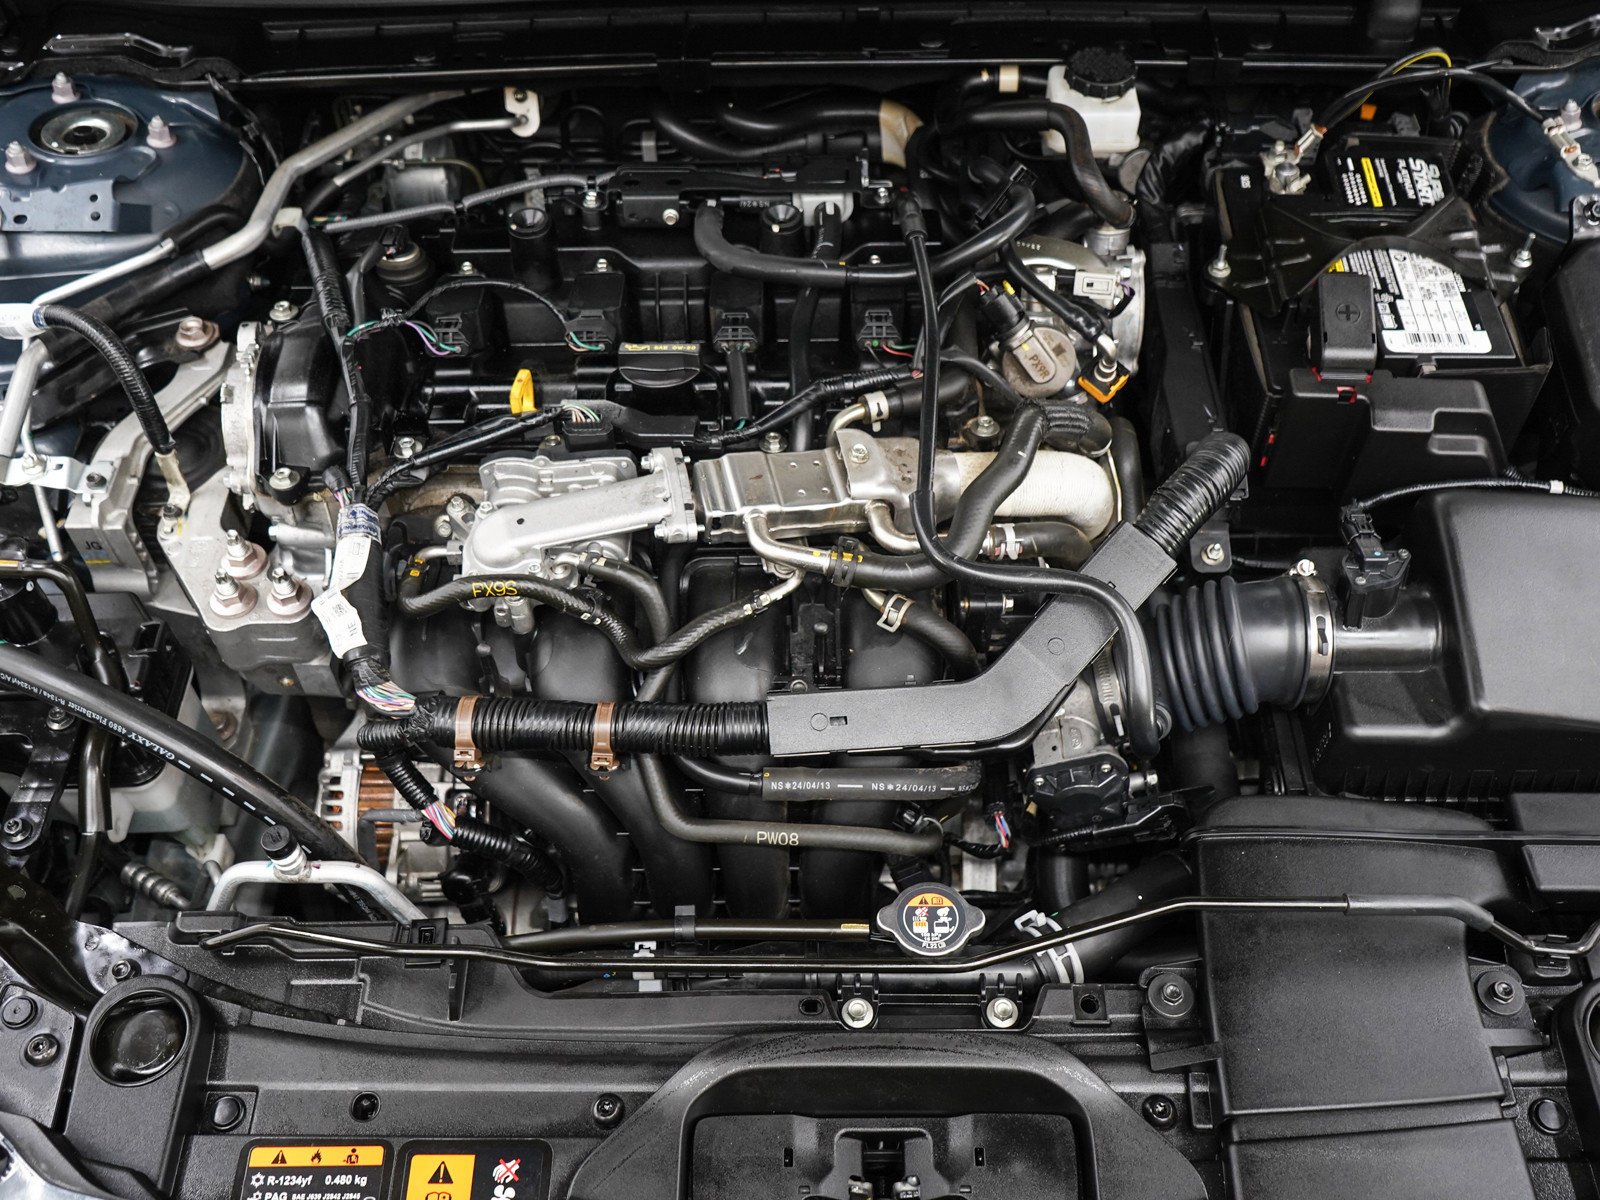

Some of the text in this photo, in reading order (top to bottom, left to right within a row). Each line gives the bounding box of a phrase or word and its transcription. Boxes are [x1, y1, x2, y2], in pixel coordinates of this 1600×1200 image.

[1409, 157, 1436, 207] START
[67, 701, 108, 726] FlexBarrier
[108, 721, 128, 735] 4880
[128, 732, 176, 760] GALAXY
[756, 831, 800, 846] PW08
[921, 941, 938, 949] FL22
[267, 1174, 368, 1188] R-1234yf 0.480 kg
[264, 1191, 288, 1200] PAG
